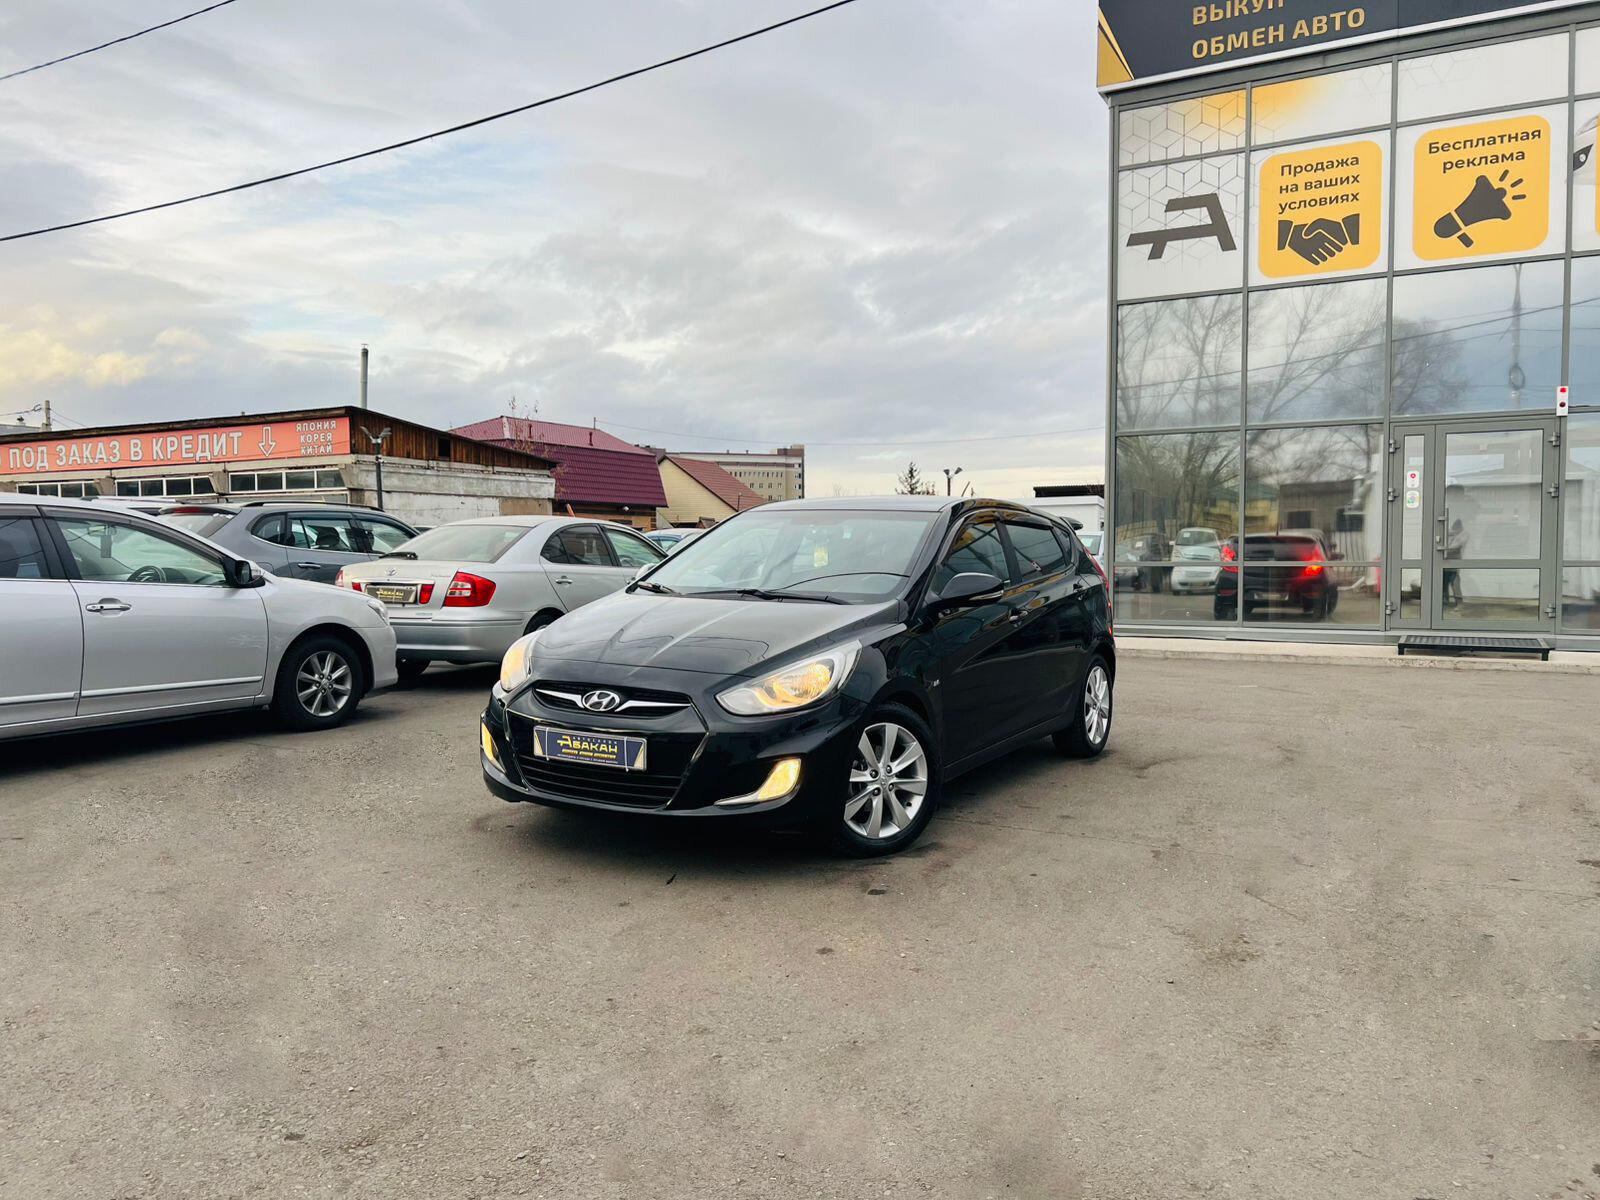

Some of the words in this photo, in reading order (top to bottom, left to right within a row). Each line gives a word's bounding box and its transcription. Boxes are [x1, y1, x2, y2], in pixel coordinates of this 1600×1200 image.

[1192, 23, 1285, 60] ОБМЕН
[1292, 7, 1366, 40] АВТО
[1428, 129, 1542, 154] Бесплатная
[1280, 156, 1360, 178] Продажа
[1442, 150, 1526, 174] реклама
[1279, 183, 1299, 195] на
[1304, 173, 1360, 191] ваших
[1278, 192, 1360, 215] условиях
[296, 420, 337, 432] ЯПОНИЯ
[300, 432, 333, 443] КОРЕЯ
[301, 442, 333, 455] КИТАЙ
[9, 445, 49, 471] ПОД
[56, 440, 121, 466] ЗАКАЗ
[129, 438, 143, 462] В
[152, 430, 243, 463] КРЕДИТ
